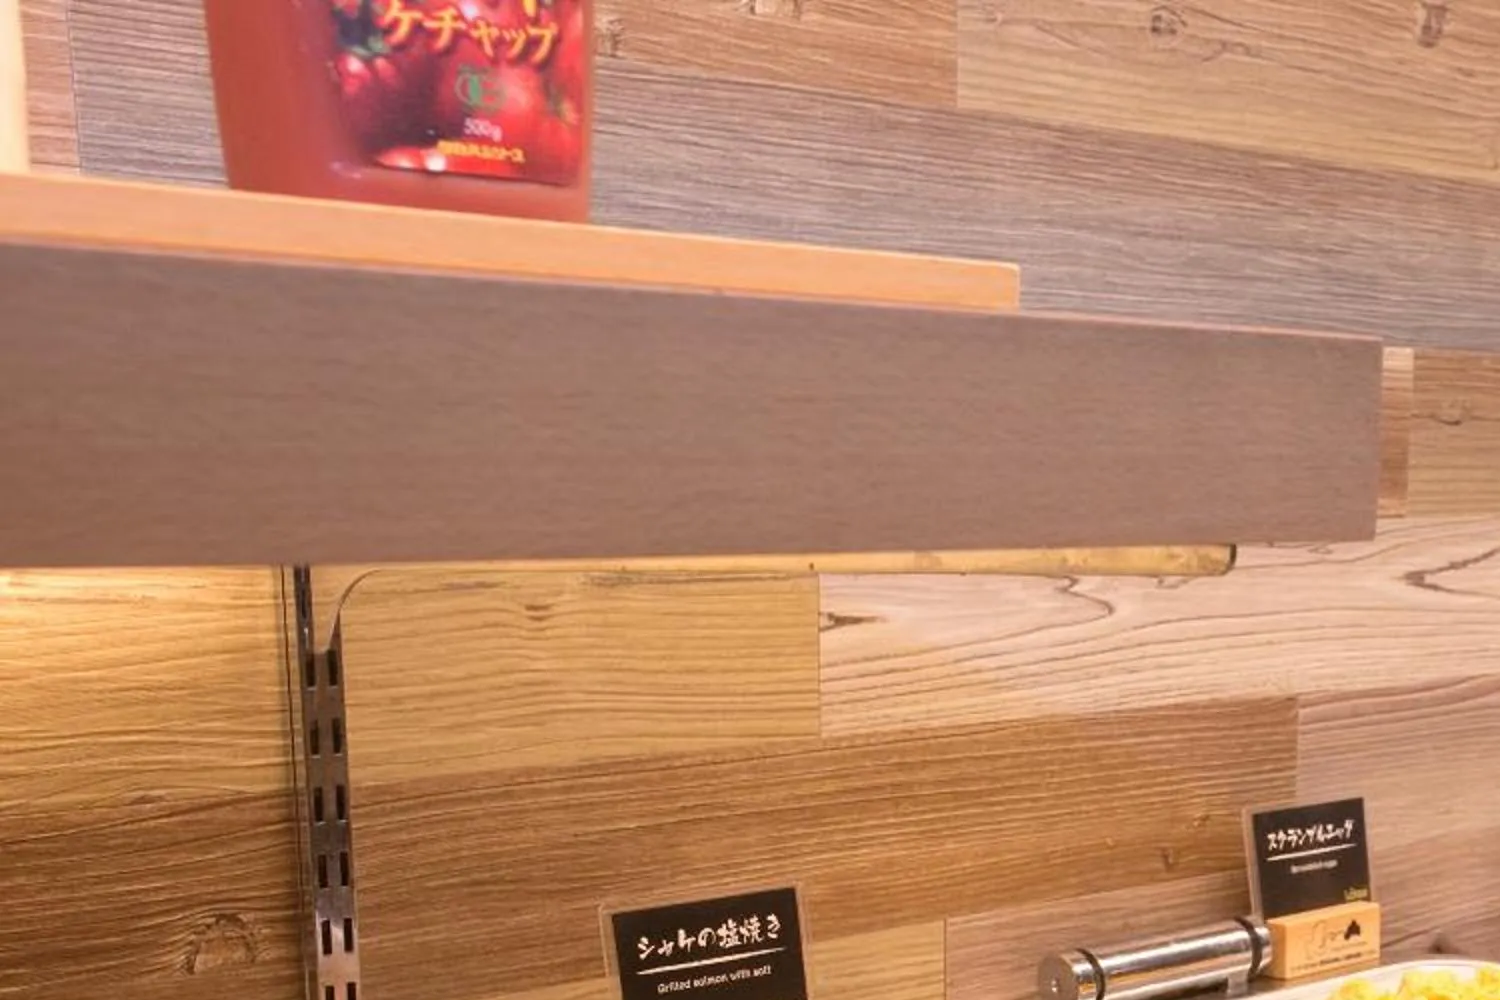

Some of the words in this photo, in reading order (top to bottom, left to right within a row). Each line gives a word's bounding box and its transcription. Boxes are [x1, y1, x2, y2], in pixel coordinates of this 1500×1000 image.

[637, 913, 782, 960] シャケの塩焼き
